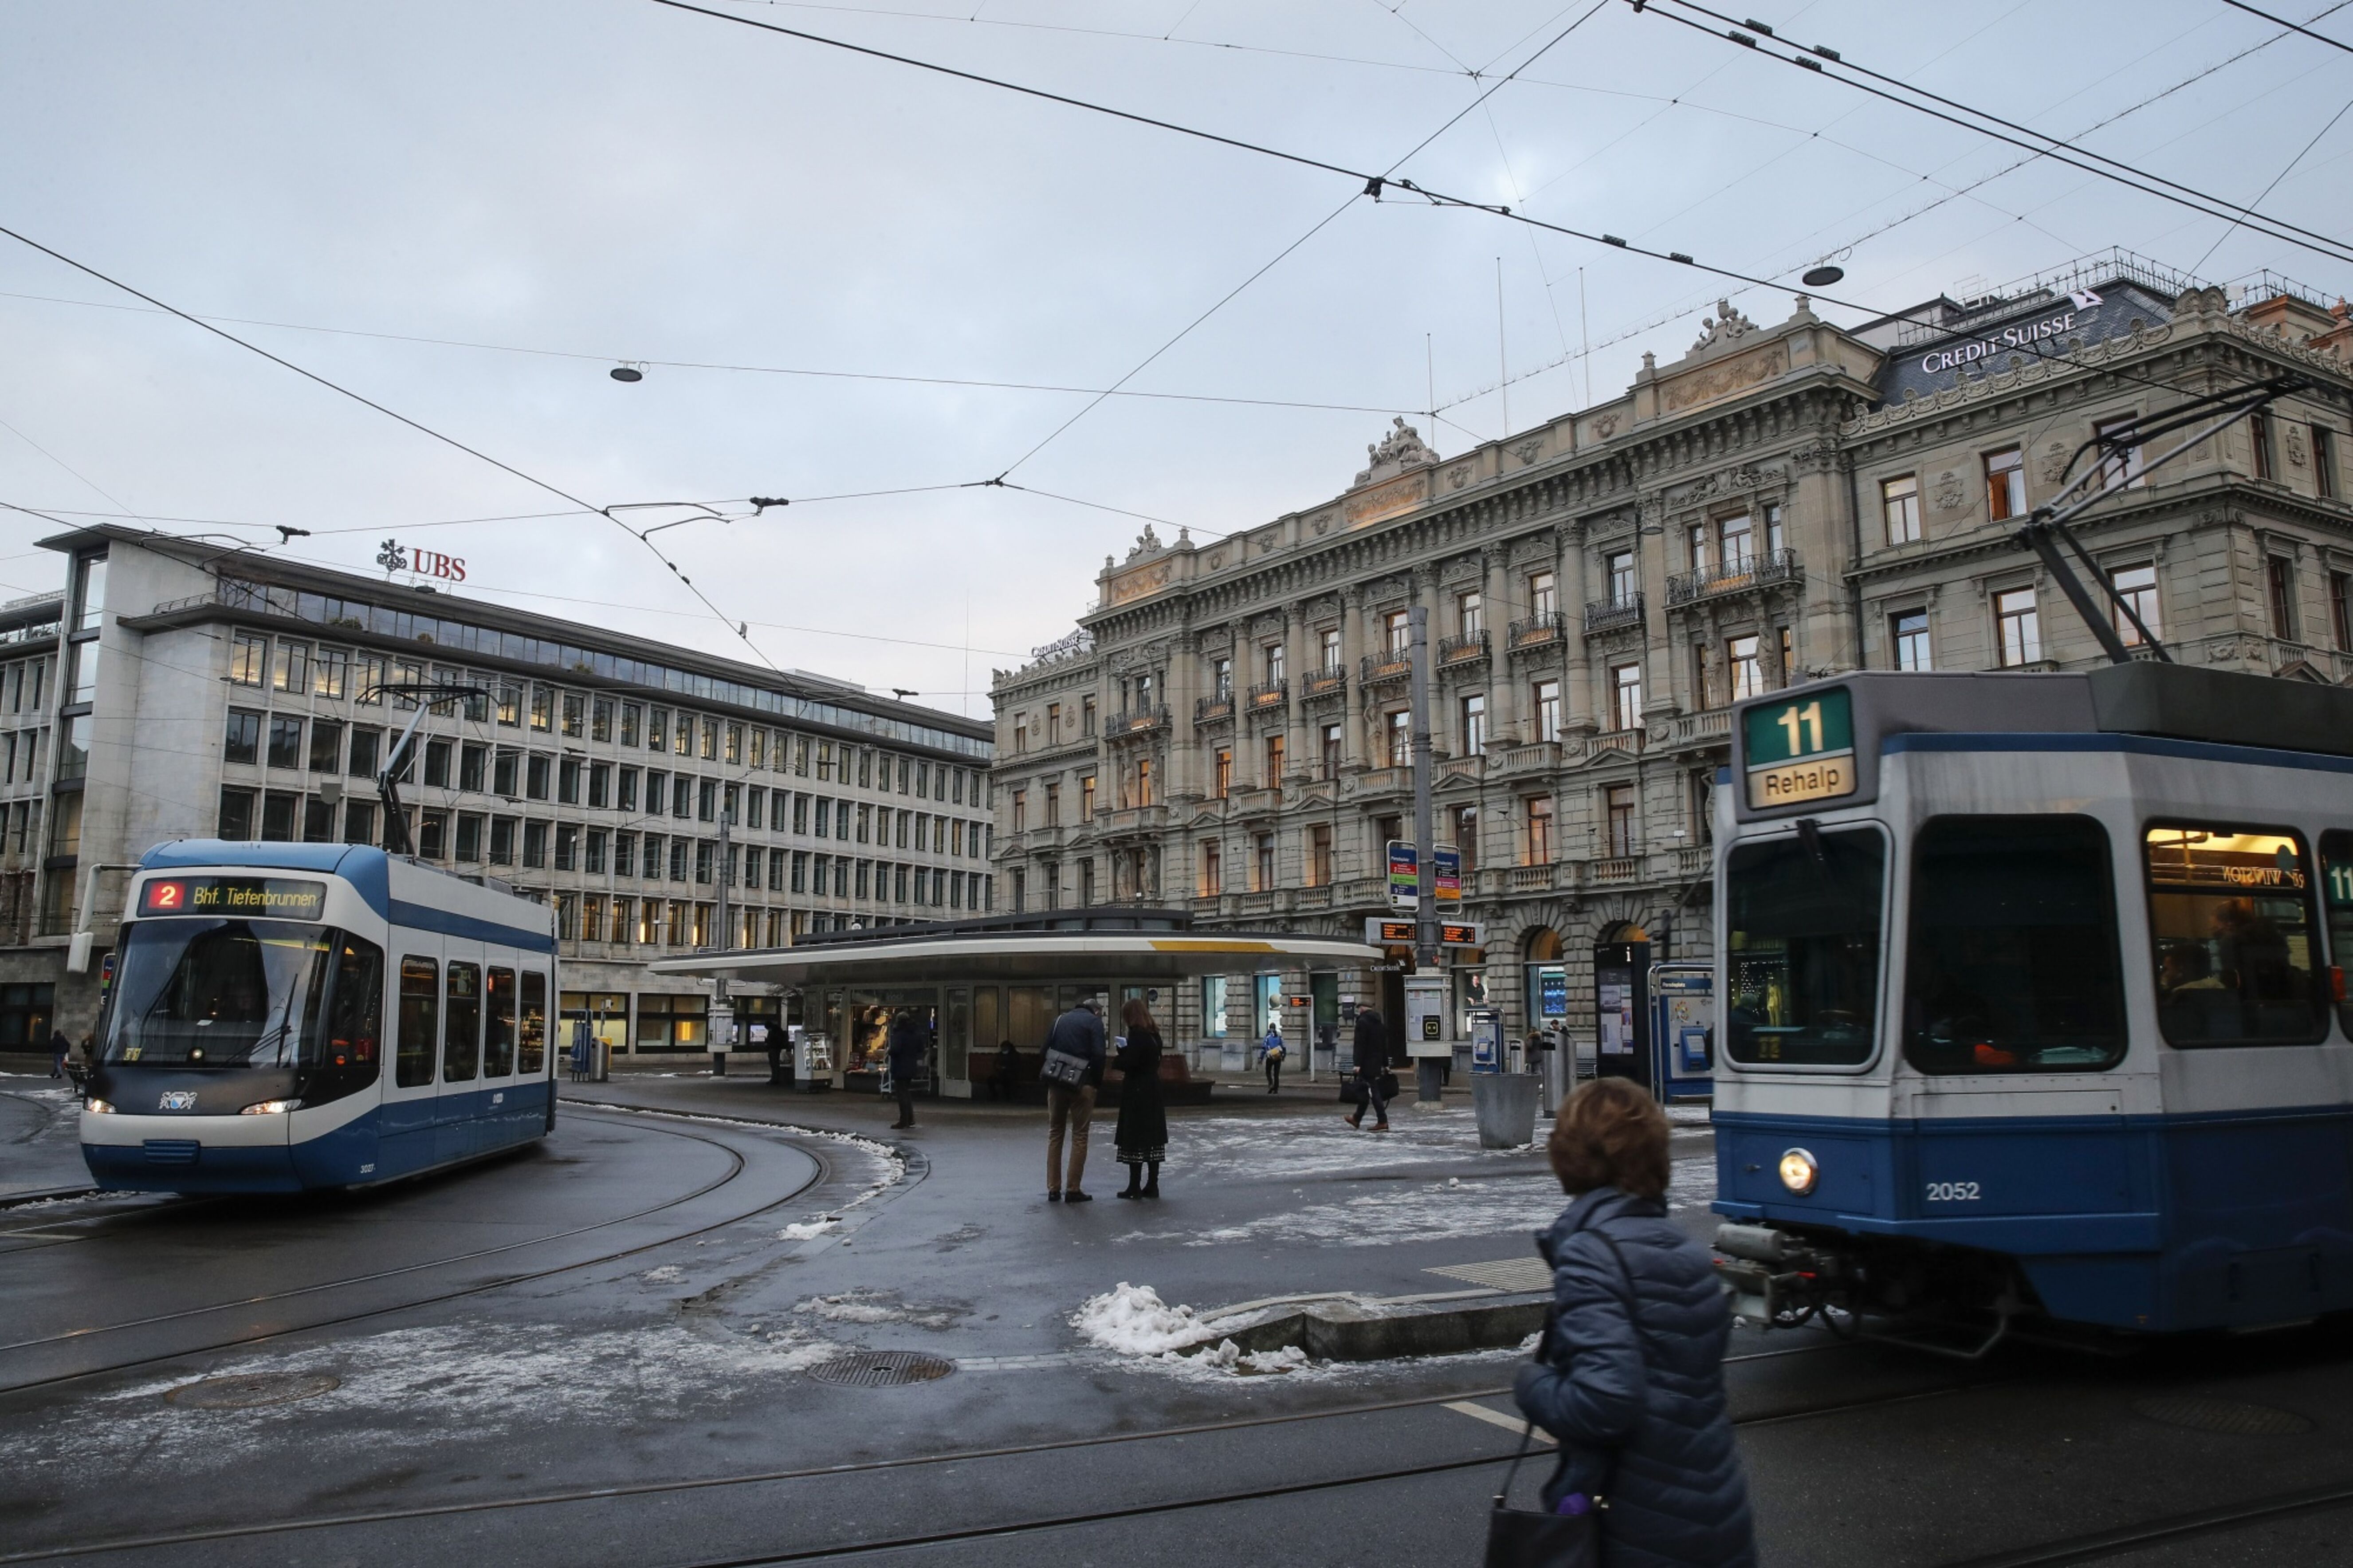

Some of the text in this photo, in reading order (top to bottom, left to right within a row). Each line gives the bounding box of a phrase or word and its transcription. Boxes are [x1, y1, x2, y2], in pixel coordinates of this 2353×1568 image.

[1922, 312, 2077, 373] CREDIT SUISSE
[414, 548, 465, 582] UBS
[1777, 702, 1823, 756] 11
[1766, 765, 1839, 797] Rehalp
[159, 885, 316, 906] 2 Bhf. Tiefenbrunnen
[1926, 1182, 1981, 1200] 2052
